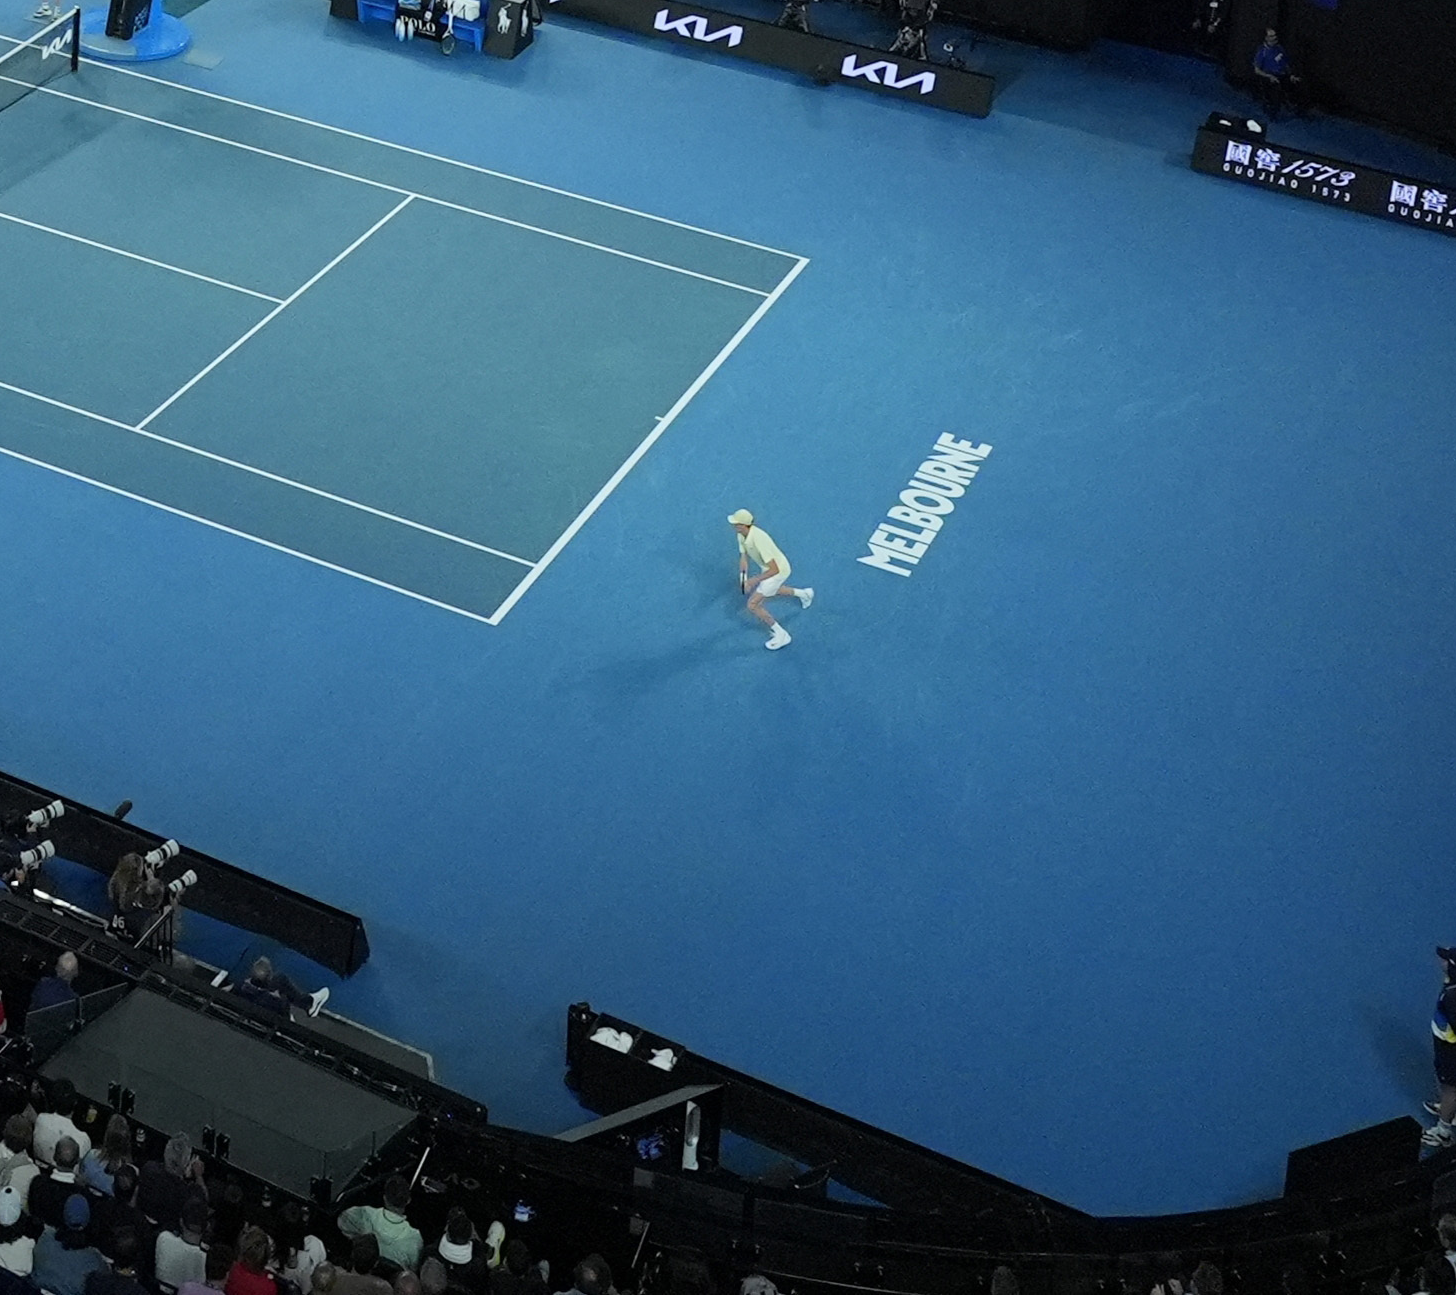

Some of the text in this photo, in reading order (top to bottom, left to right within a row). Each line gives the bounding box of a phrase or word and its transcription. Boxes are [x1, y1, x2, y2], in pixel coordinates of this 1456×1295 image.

[400, 15, 436, 33] POLO
[654, 9, 743, 48] KIA
[841, 54, 936, 95] KIA
[1222, 163, 1351, 202] GUOJIAO 1573
[856, 432, 993, 577] MELBOURNE
